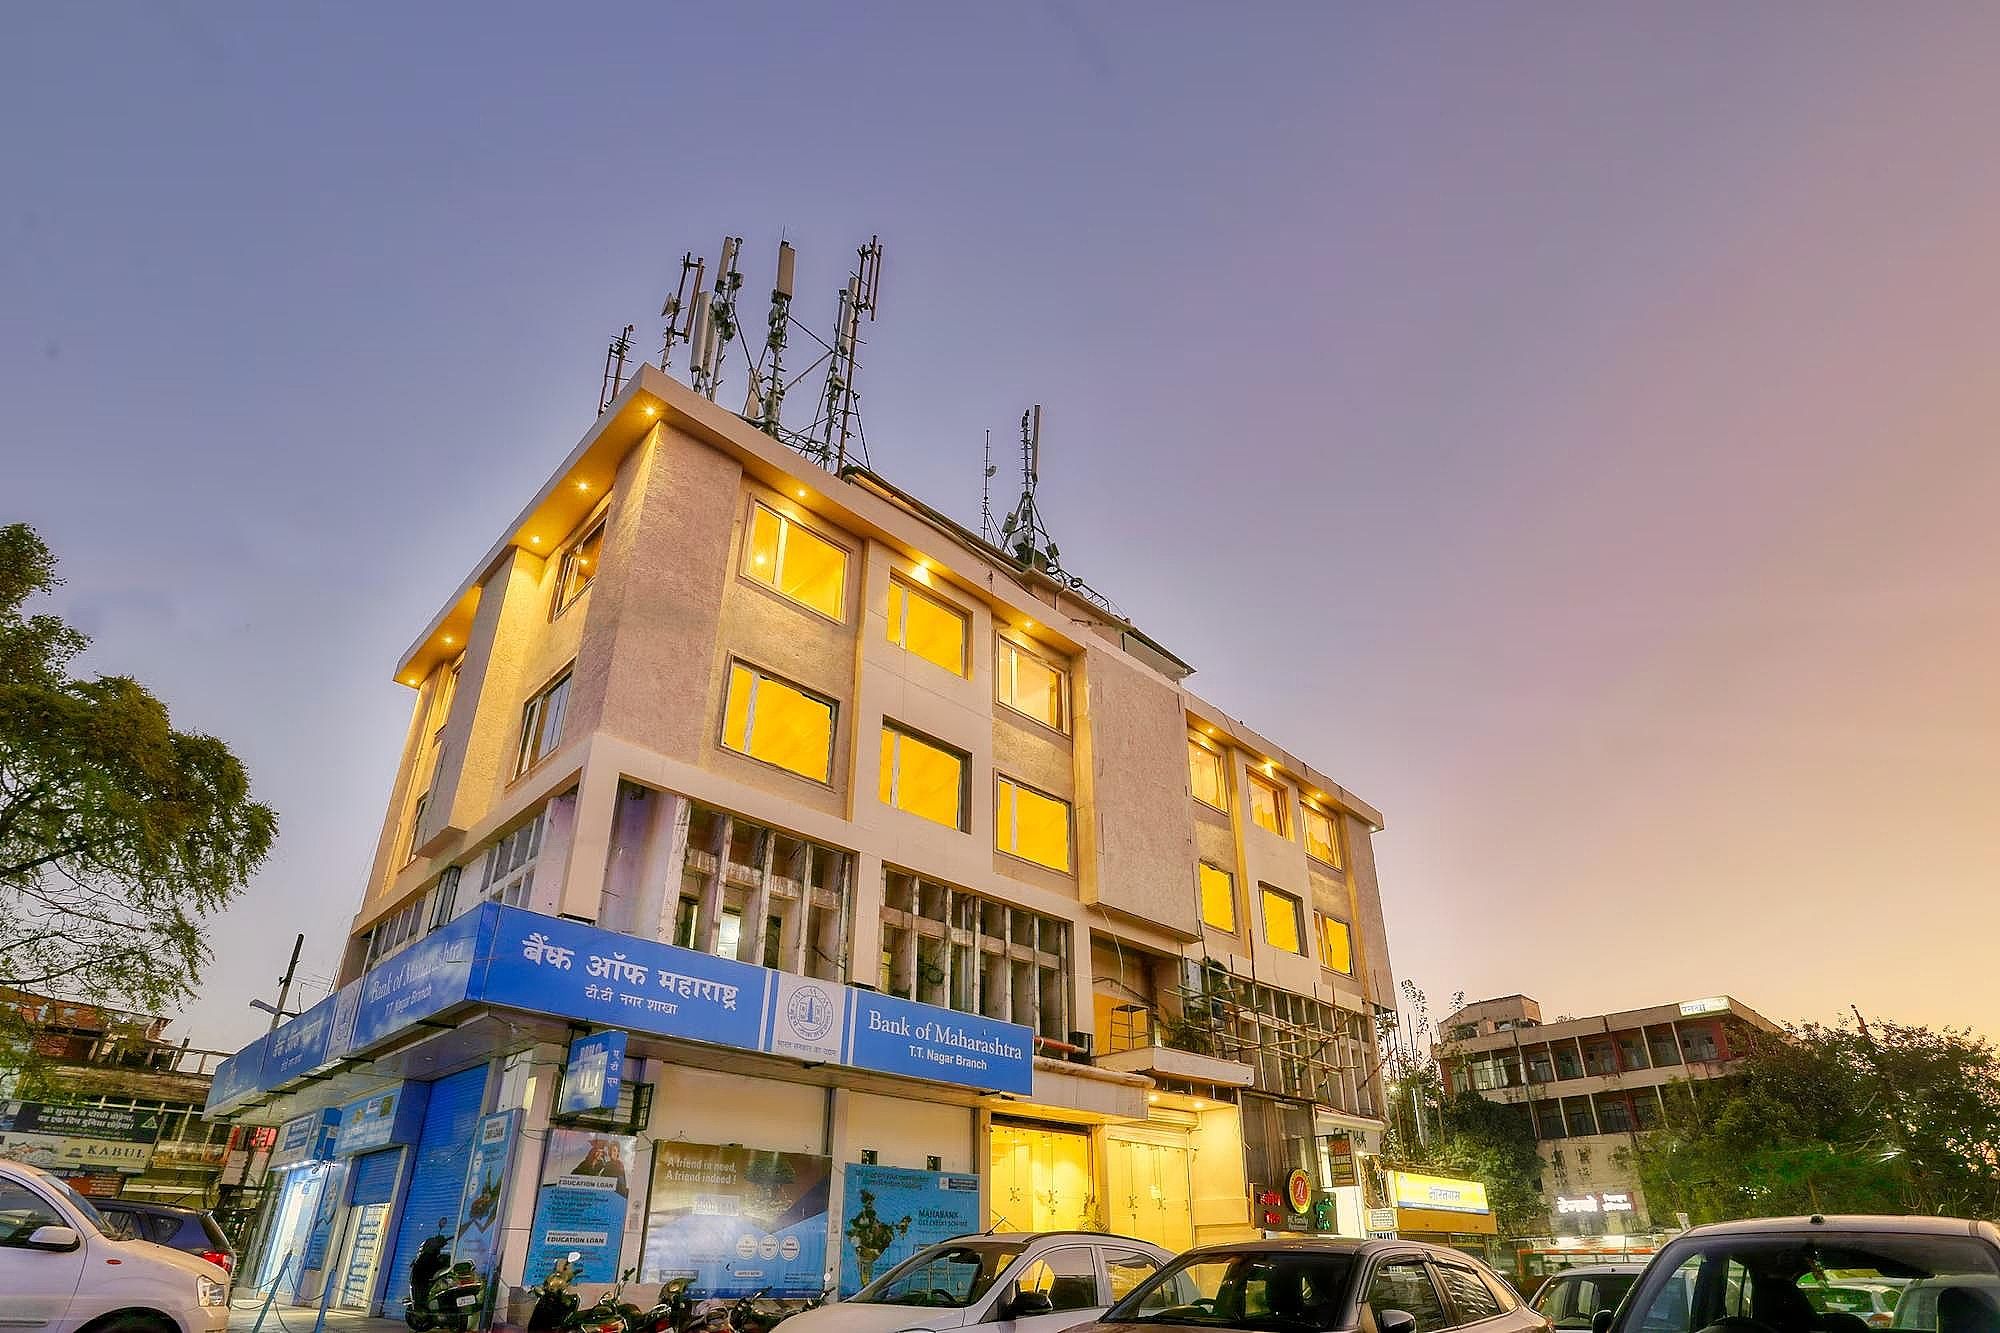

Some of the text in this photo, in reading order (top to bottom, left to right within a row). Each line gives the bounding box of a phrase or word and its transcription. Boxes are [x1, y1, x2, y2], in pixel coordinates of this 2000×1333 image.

[522, 933, 739, 1011] बैंक ऑफ महाराष्ट्र
[371, 976, 393, 1003] Bank
[393, 964, 405, 991] of
[620, 992, 643, 1009] नगर
[647, 999, 678, 1015] शाखा
[868, 1010, 1023, 1060] Bank of Maharashtra
[927, 1049, 954, 1065] Nagar
[956, 1054, 987, 1070] Branch
[676, 1159, 701, 1170] friend
[558, 1179, 596, 1188] EDUCATION
[675, 1171, 701, 1183] friend
[701, 1173, 731, 1184] indeed
[547, 1235, 605, 1245] EDUCATION LOAN
